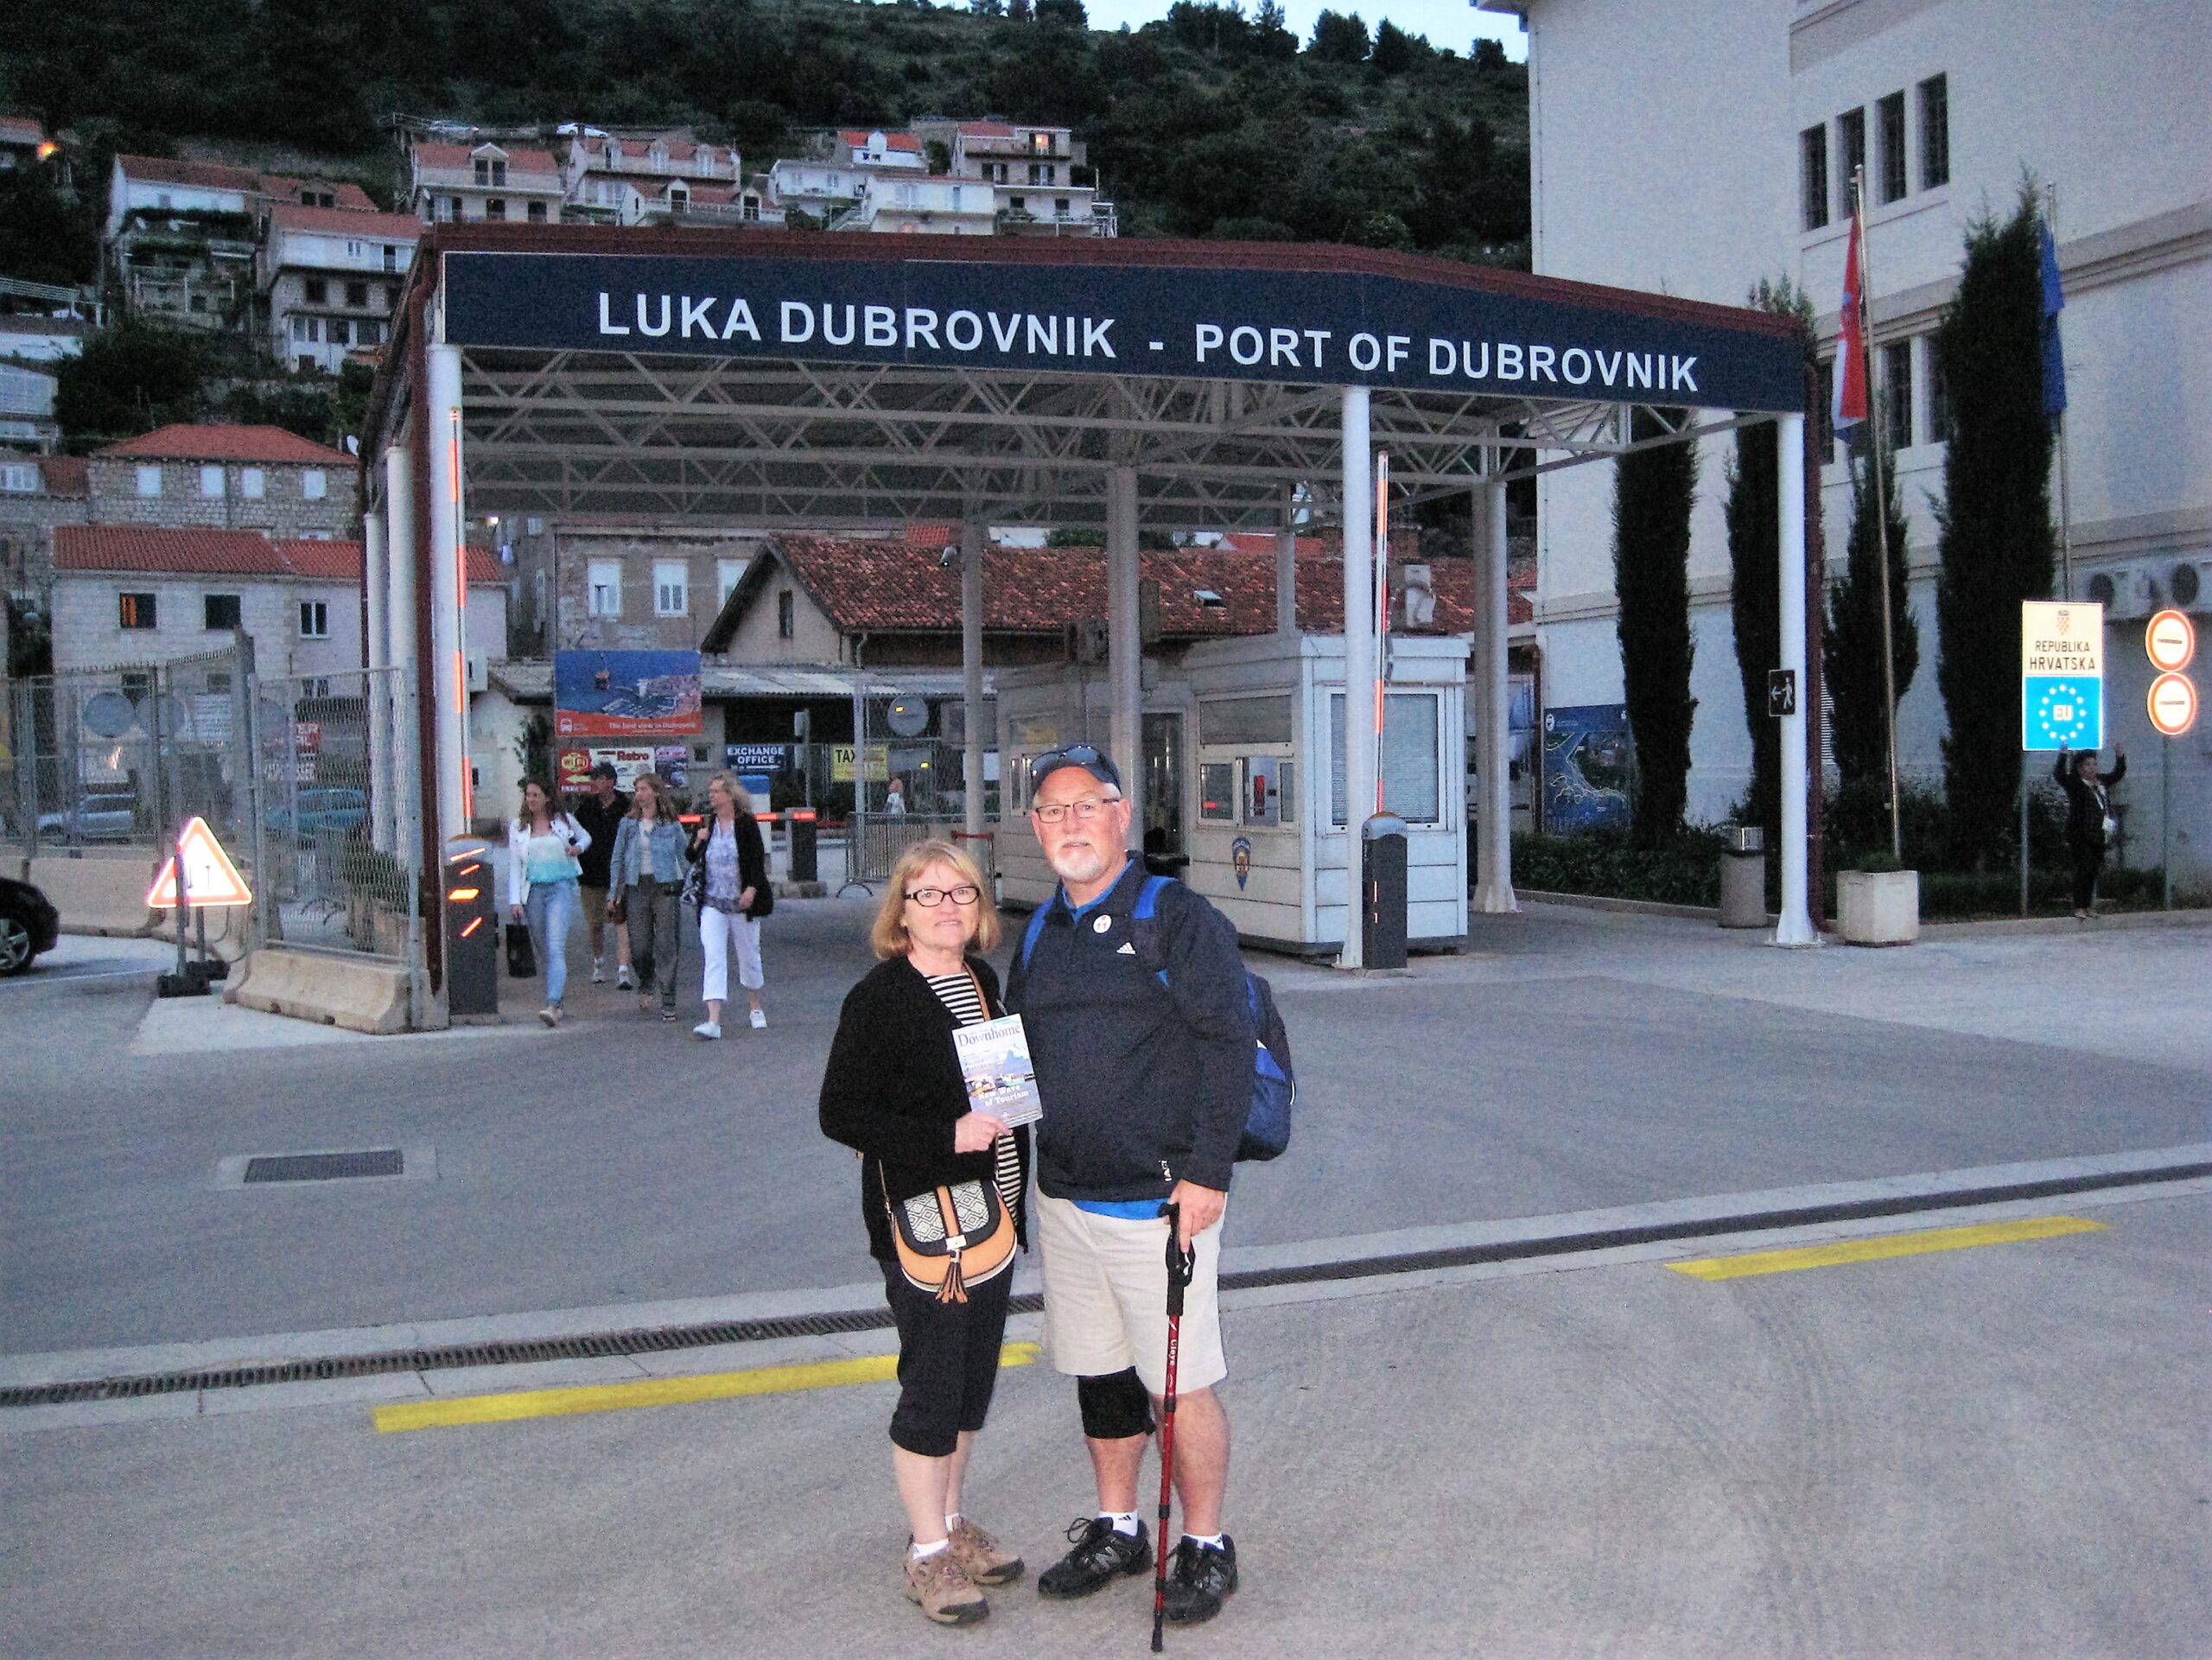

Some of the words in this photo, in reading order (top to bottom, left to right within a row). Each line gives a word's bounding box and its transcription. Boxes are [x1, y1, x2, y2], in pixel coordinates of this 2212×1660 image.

[599, 292, 762, 341] LUKA
[780, 301, 1116, 359] DUBROVNIK
[1149, 340, 1164, 351] -
[1195, 324, 1332, 368] PORT
[1349, 333, 1411, 372] OF
[1428, 338, 1699, 392] DUBROVNIK
[2035, 640, 2091, 652] REPUBLIKA
[2029, 657, 2096, 671] HRVATSKA
[616, 750, 650, 761] Retro
[727, 746, 785, 756] EXCHANGE
[737, 755, 775, 765] OFFICE
[957, 1025, 1020, 1047] Downhome
[977, 1090, 996, 1101] New
[997, 1084, 1021, 1094] Wave
[984, 1098, 994, 1107] of
[995, 1091, 1030, 1104] Tourism
